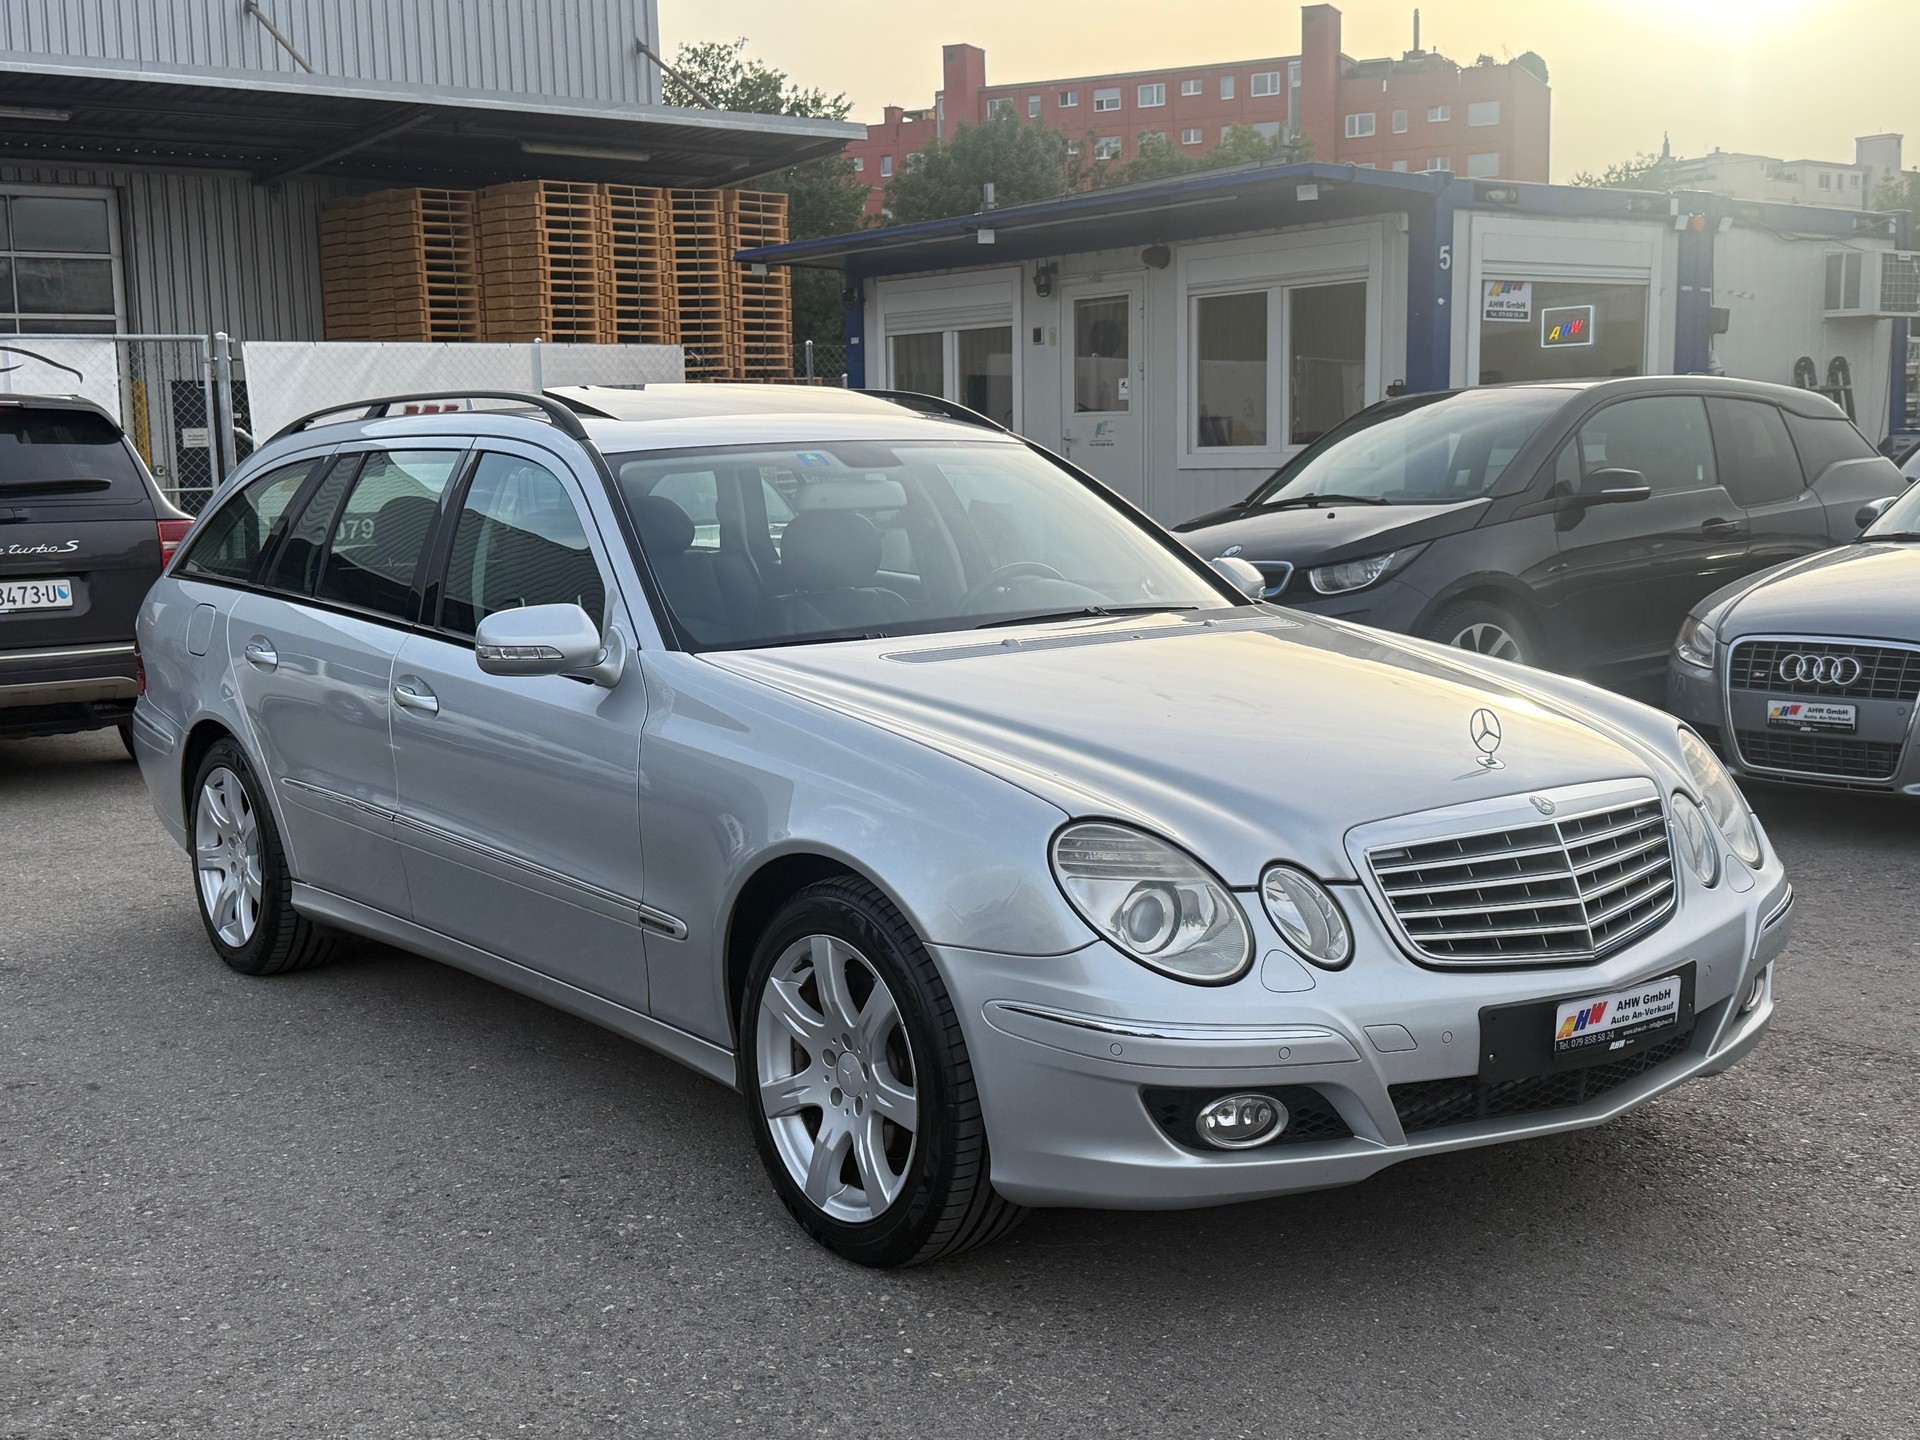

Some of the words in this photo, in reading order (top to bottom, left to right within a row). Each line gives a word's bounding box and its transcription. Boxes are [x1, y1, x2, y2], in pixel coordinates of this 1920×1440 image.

[1439, 245, 1450, 270] 5
[1488, 301, 1504, 309] AHW
[1505, 301, 1526, 310] GmbH
[1549, 319, 1584, 341] AHW
[9, 544, 58, 555] turbo
[57, 540, 80, 553] S
[1769, 704, 1802, 718] AHW
[1826, 708, 1849, 716] GmbH
[1616, 996, 1641, 1012] AHW
[1642, 988, 1672, 1005] GmbH
[1556, 1001, 1608, 1040] AHW
[1610, 1014, 1630, 1025] Auto
[1631, 1002, 1675, 1019] An-Verkauf
[1559, 1041, 1570, 1050] Tel.
[1570, 1038, 1584, 1048] 079
[1606, 1030, 1615, 1040] 24
